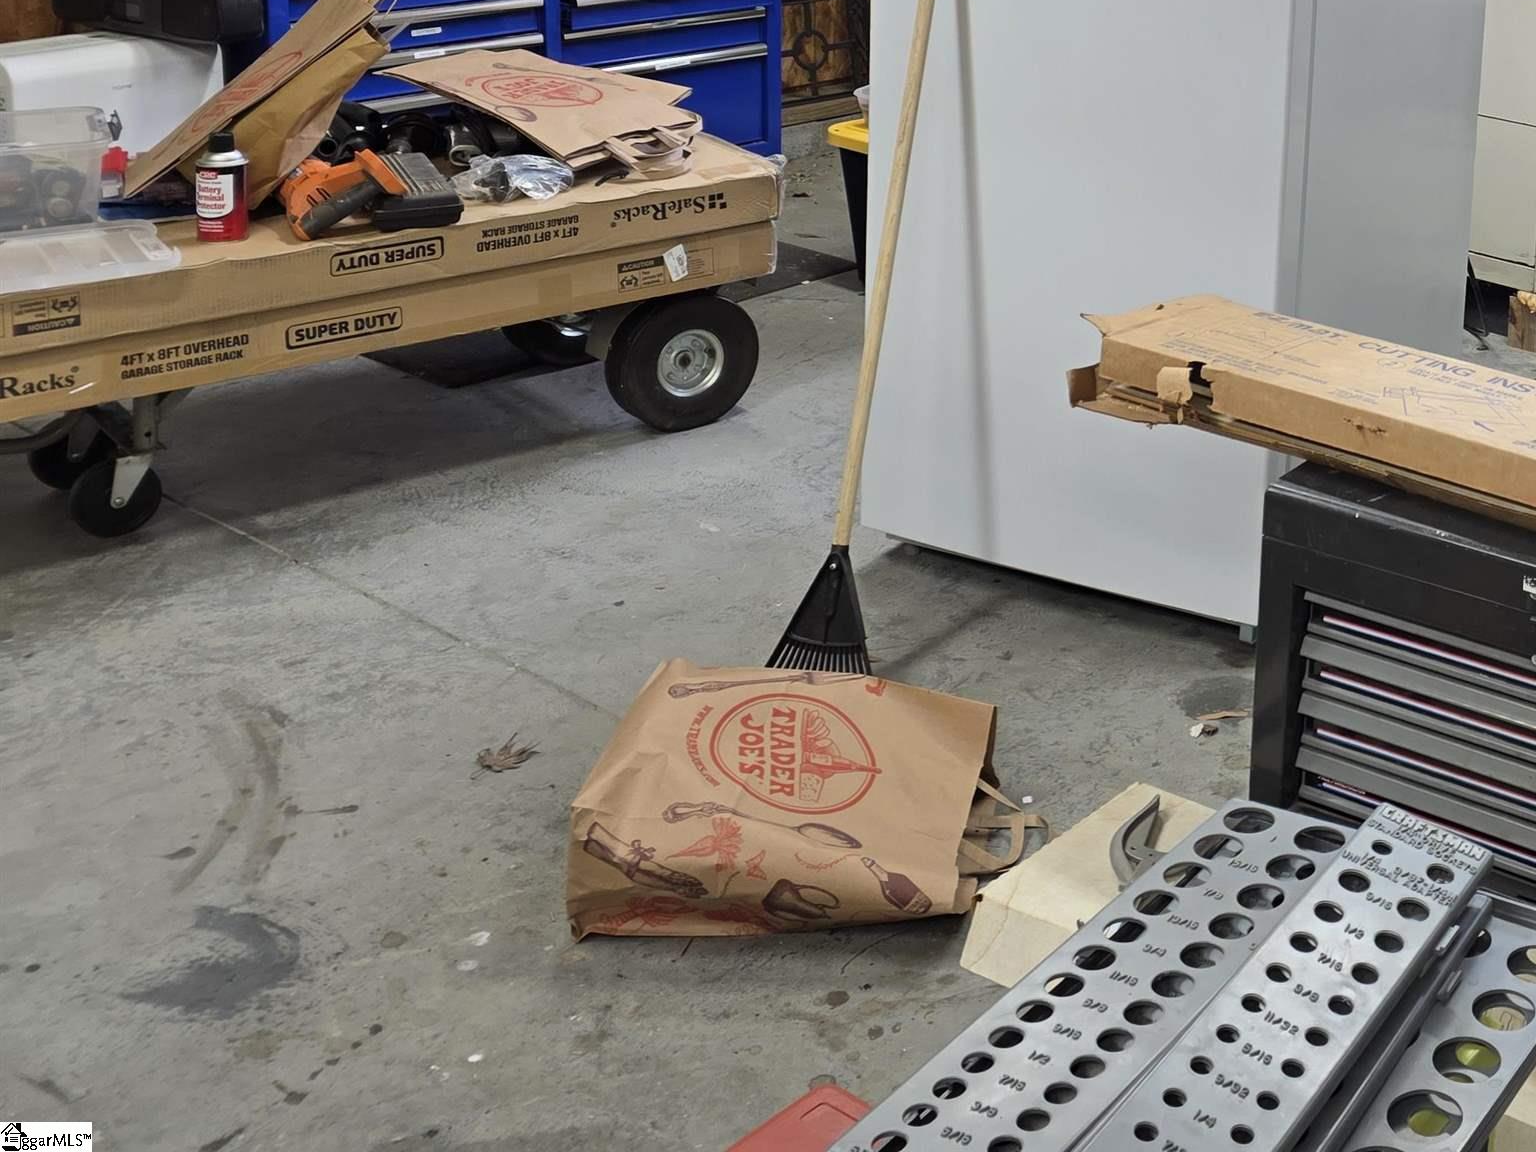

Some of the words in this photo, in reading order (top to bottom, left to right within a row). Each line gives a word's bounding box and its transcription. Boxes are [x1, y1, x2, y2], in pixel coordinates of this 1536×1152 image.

[482, 225, 505, 238] RACK
[508, 220, 545, 234] STORAGE
[546, 215, 579, 227] GARAGE
[558, 227, 579, 240] 4FT
[476, 234, 531, 253] OVERHEAD
[533, 229, 551, 244] 8FT
[336, 253, 380, 272] DUTY
[384, 242, 436, 264] SUPER
[295, 321, 349, 343] SUPER
[354, 311, 398, 332] DUTY
[120, 352, 144, 367] 4FT
[158, 346, 181, 361] 8FT
[184, 334, 249, 356] OVERHEAD
[1358, 341, 1477, 378] CUTTING
[121, 364, 164, 380] GARAGE
[166, 356, 214, 372] STORAGE
[215, 349, 244, 364] RACK
[738, 713, 766, 781] JOE'S
[769, 706, 797, 797] TRADER
[1381, 804, 1487, 862] CRAFTSMAN
[1367, 818, 1426, 850] STANDARD
[1426, 847, 1478, 876] SOCKETS
[1264, 1010, 1300, 1036] 11/32
[1241, 1043, 1273, 1067] 5/16
